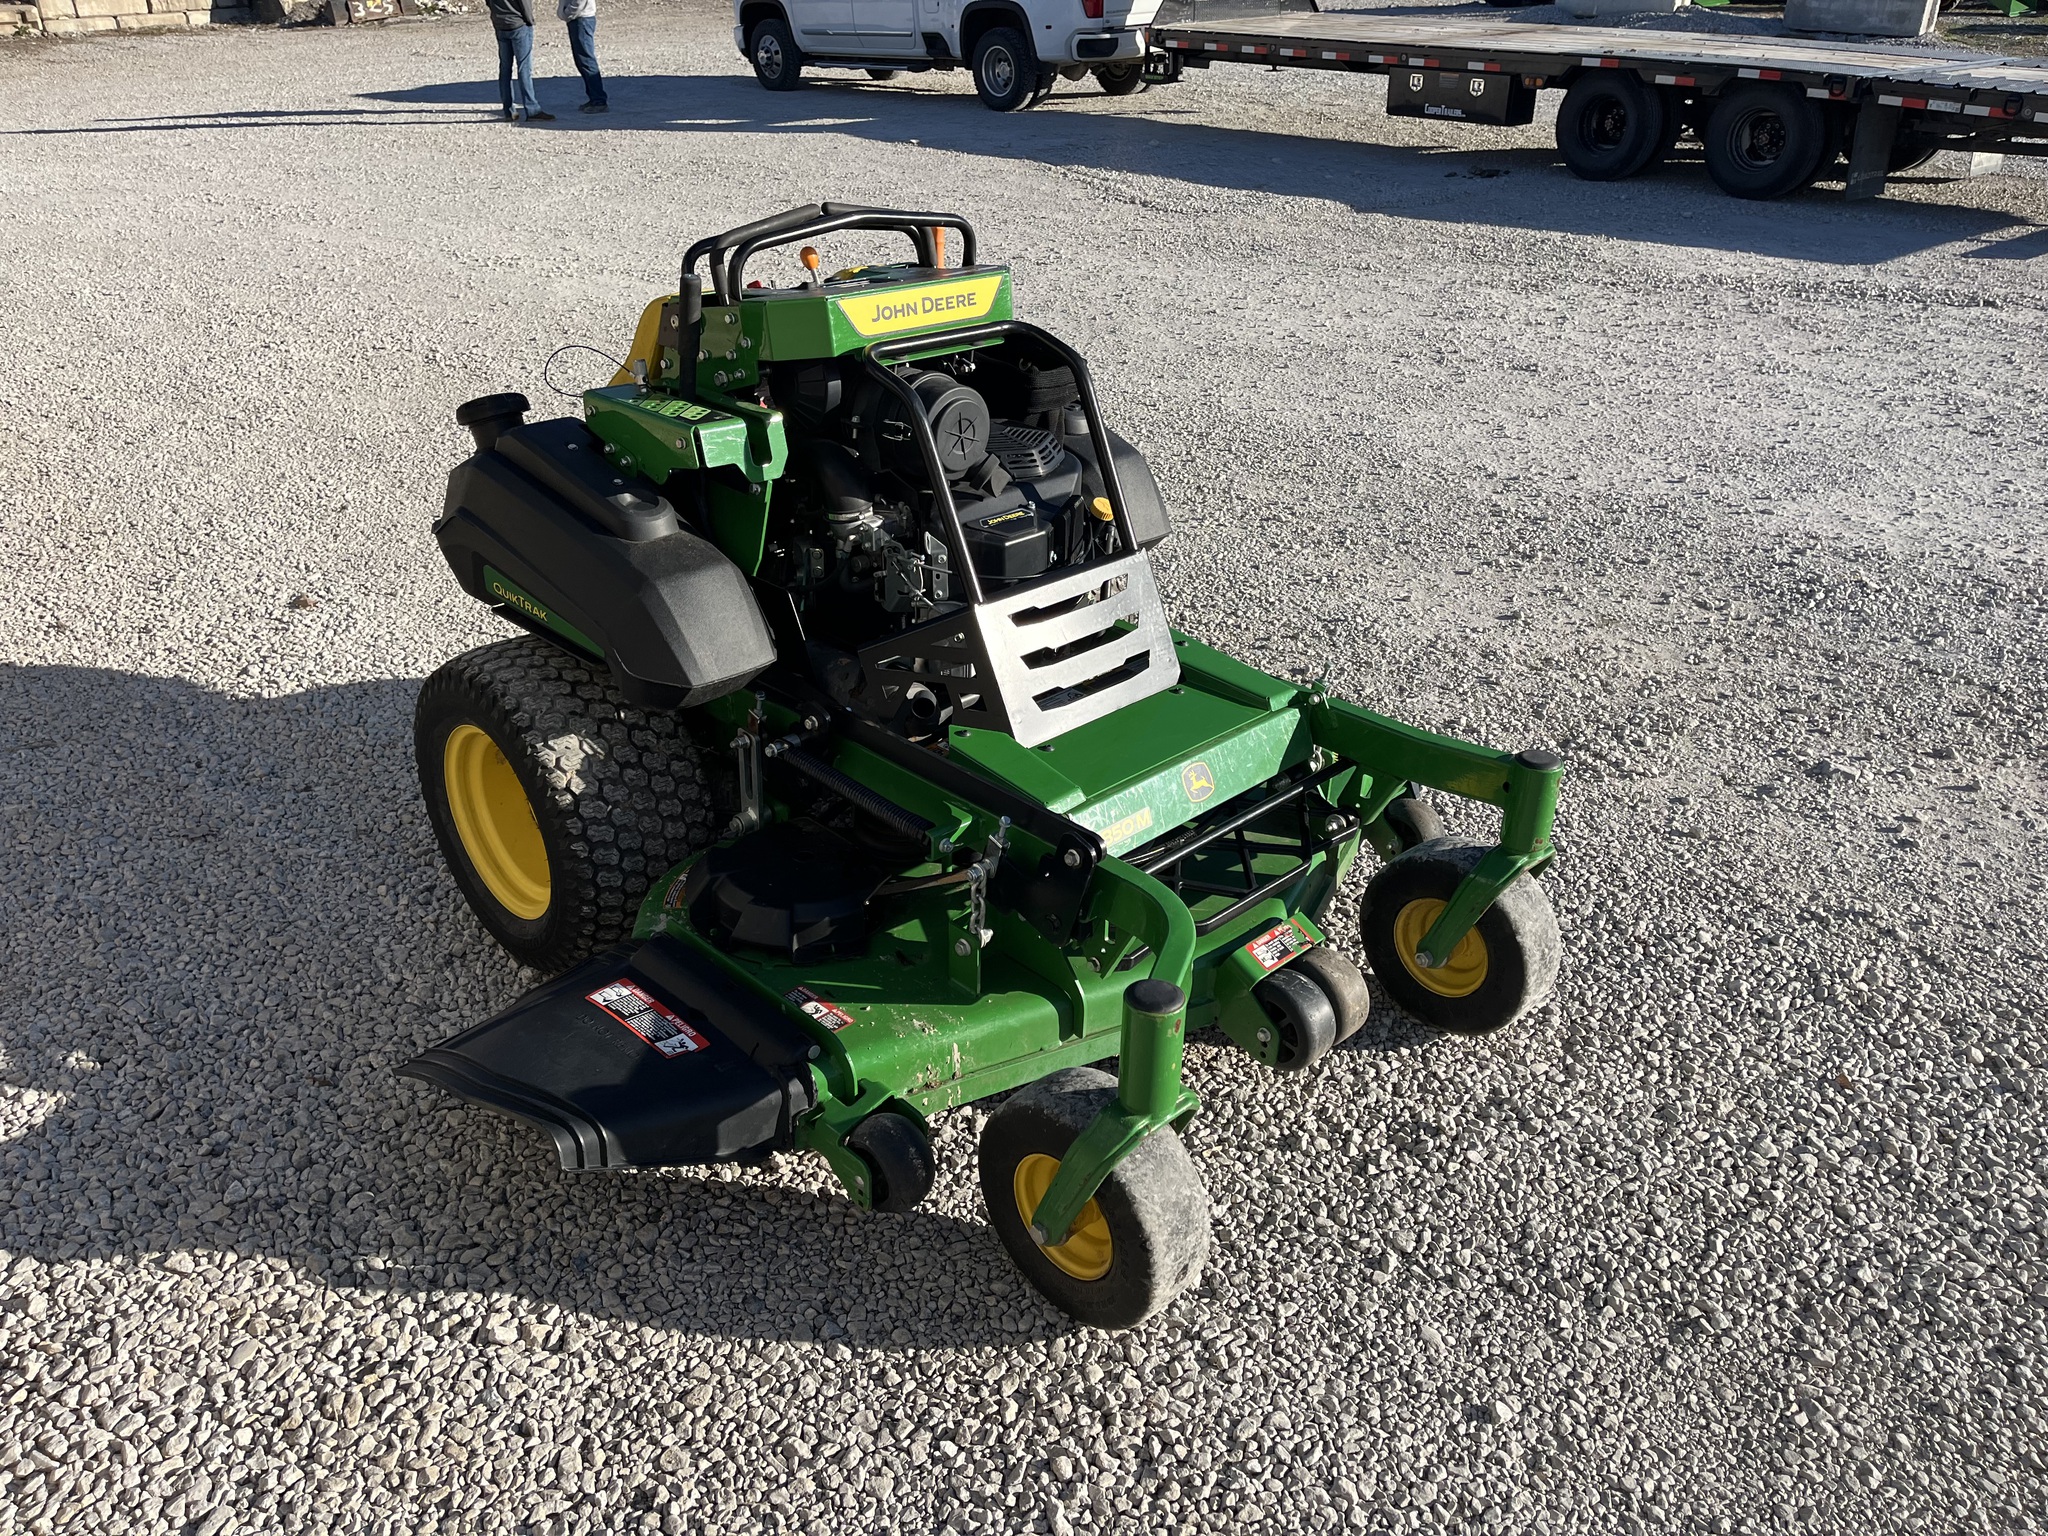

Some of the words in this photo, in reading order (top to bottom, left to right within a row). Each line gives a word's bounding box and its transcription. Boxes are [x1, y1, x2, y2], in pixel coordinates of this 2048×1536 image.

[872, 302, 918, 322] JOHN
[921, 292, 977, 314] DEERE
[493, 582, 548, 621] QUIKTRAK
[634, 987, 655, 1004] DANGER
[673, 1017, 697, 1037] PELIGRO
